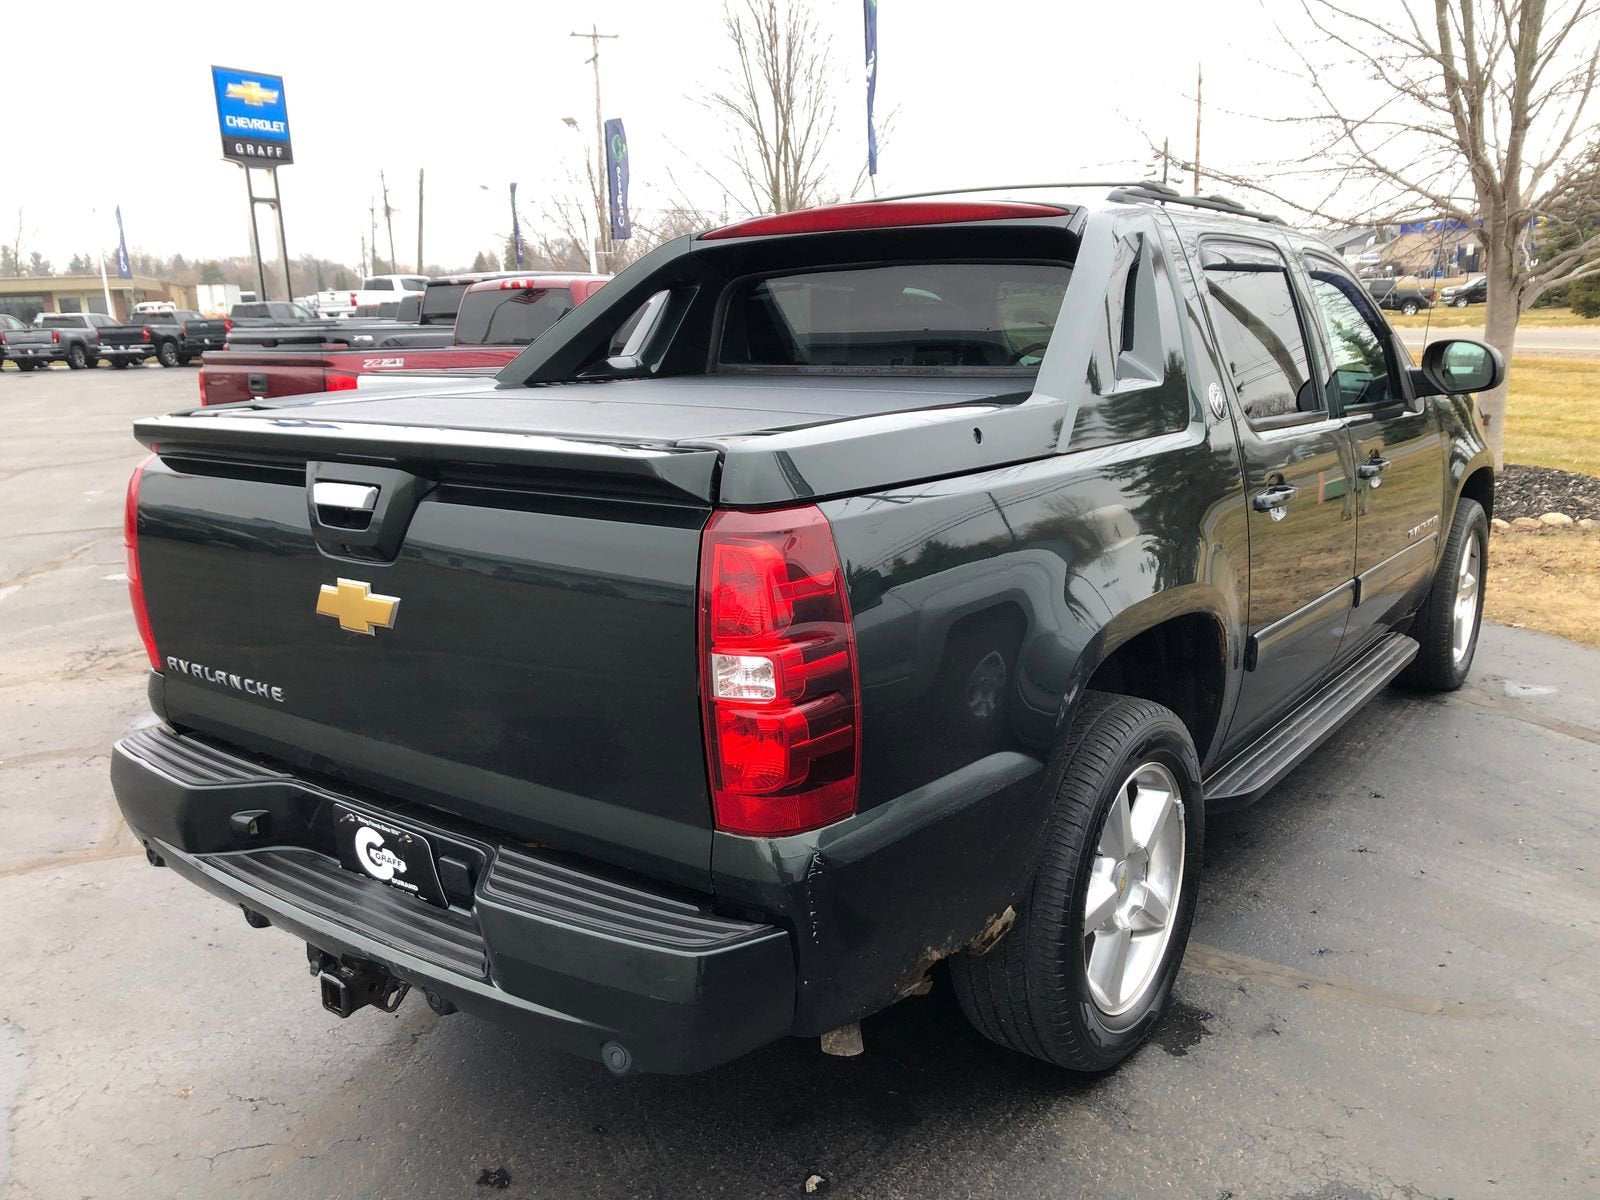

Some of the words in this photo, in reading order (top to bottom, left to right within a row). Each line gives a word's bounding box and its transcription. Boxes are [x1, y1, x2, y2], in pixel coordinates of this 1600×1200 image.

[225, 115, 285, 133] CHEVROLET
[235, 143, 282, 157] GRAFF
[166, 656, 286, 702] AVALANCHE
[375, 852, 402, 867] GRAFF
